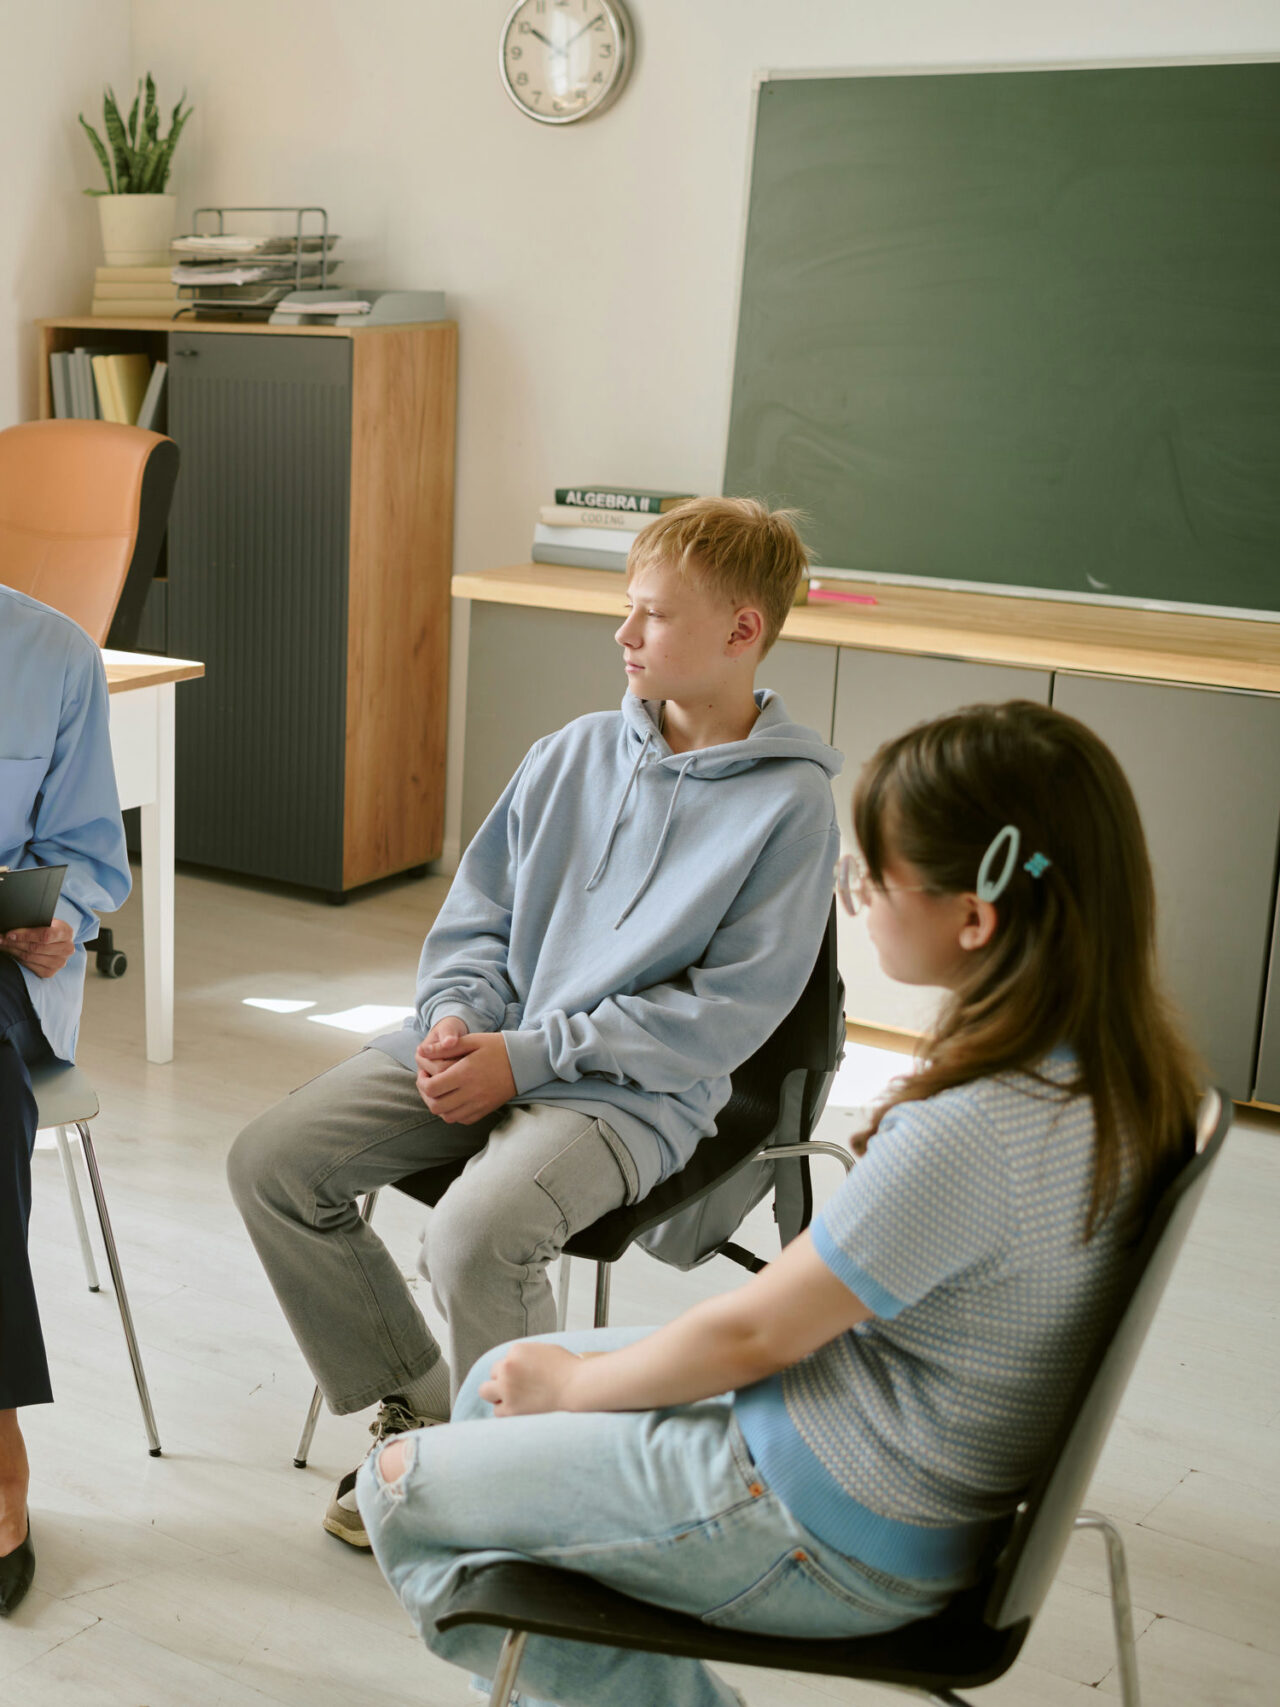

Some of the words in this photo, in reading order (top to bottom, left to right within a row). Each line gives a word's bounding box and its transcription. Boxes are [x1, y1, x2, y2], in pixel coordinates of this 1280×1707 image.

[519, 21, 531, 35] 10
[511, 46, 522, 60] 9
[599, 43, 611, 58] 3
[516, 71, 528, 86] 8
[593, 71, 603, 83] 4
[531, 90, 542, 104] 7
[566, 491, 637, 511] ALGEBRA
[640, 497, 650, 512] II
[581, 512, 624, 525] CODING
